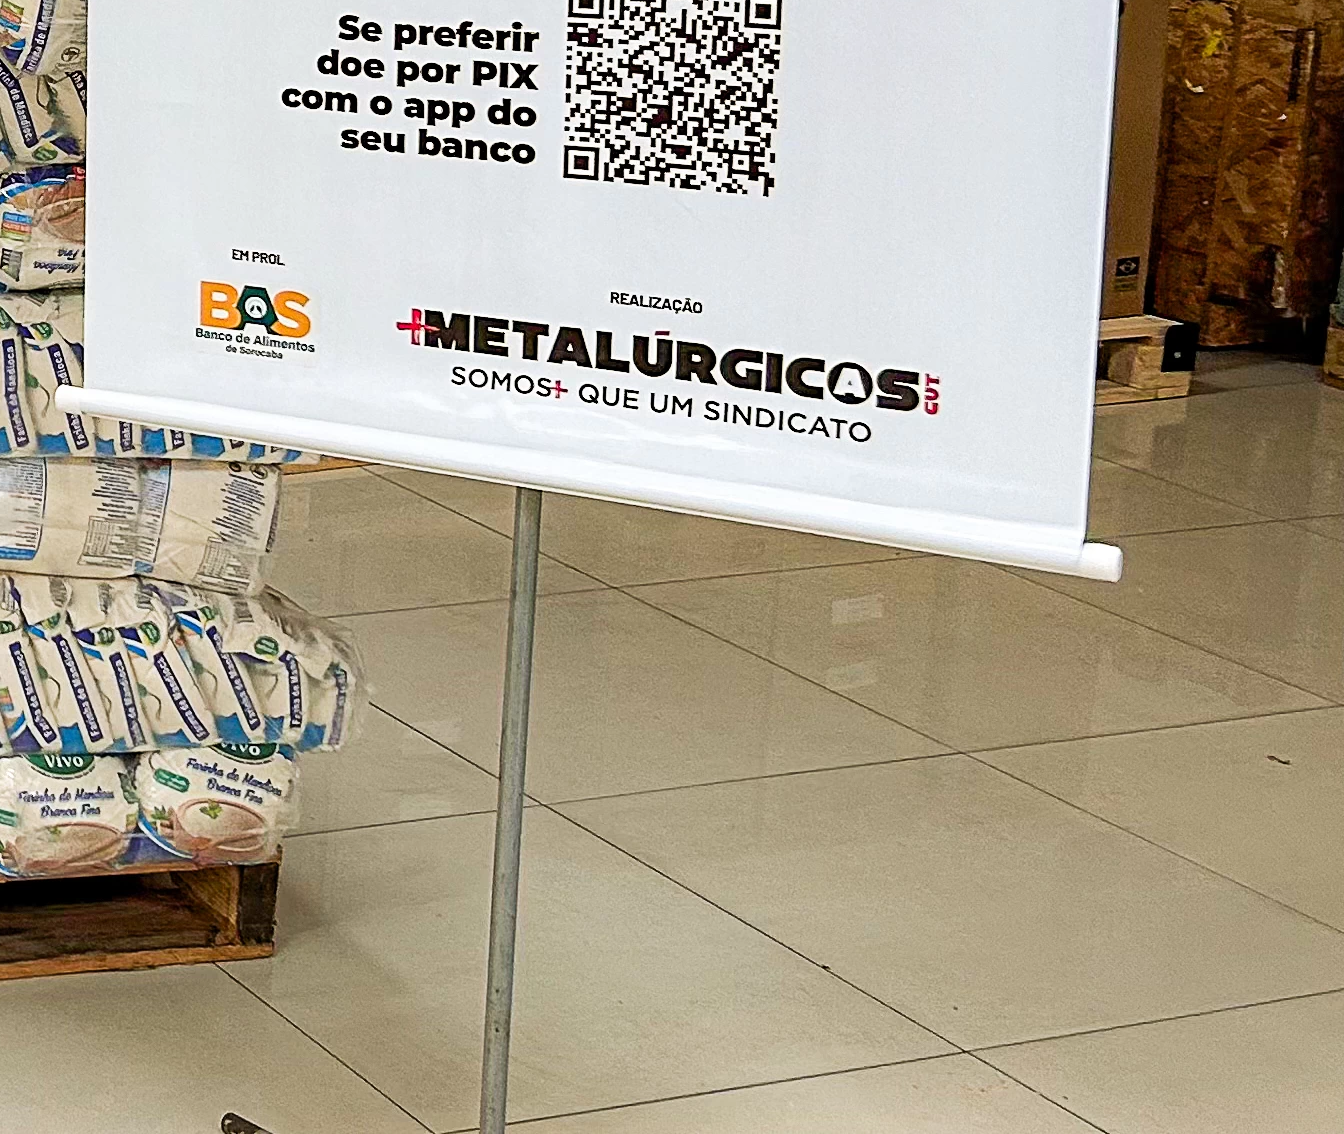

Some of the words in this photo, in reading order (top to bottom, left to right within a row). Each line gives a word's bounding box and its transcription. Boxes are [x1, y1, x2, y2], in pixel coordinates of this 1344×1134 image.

[338, 13, 382, 43] Se
[394, 18, 541, 58] preferir
[317, 50, 386, 83] doe
[396, 58, 460, 91] por
[473, 60, 539, 91] PIX
[281, 86, 359, 115] com
[369, 93, 392, 117] o
[402, 94, 476, 127] app
[487, 96, 538, 129] do
[341, 126, 407, 155] seu
[418, 126, 536, 165] banco
[232, 248, 249, 261] EM
[252, 252, 286, 266] PROL
[200, 281, 310, 338] BAS
[609, 290, 704, 315] REALIZAÇÃO
[196, 328, 232, 341] Banco
[236, 333, 250, 344] de
[253, 336, 315, 352] Alimentos
[226, 345, 237, 354] de
[578, 383, 639, 409] QUE
[650, 392, 694, 418] UM
[703, 400, 872, 442] SINDICATO
[924, 373, 942, 415] CUT
[44, 752, 85, 769] Vivo
